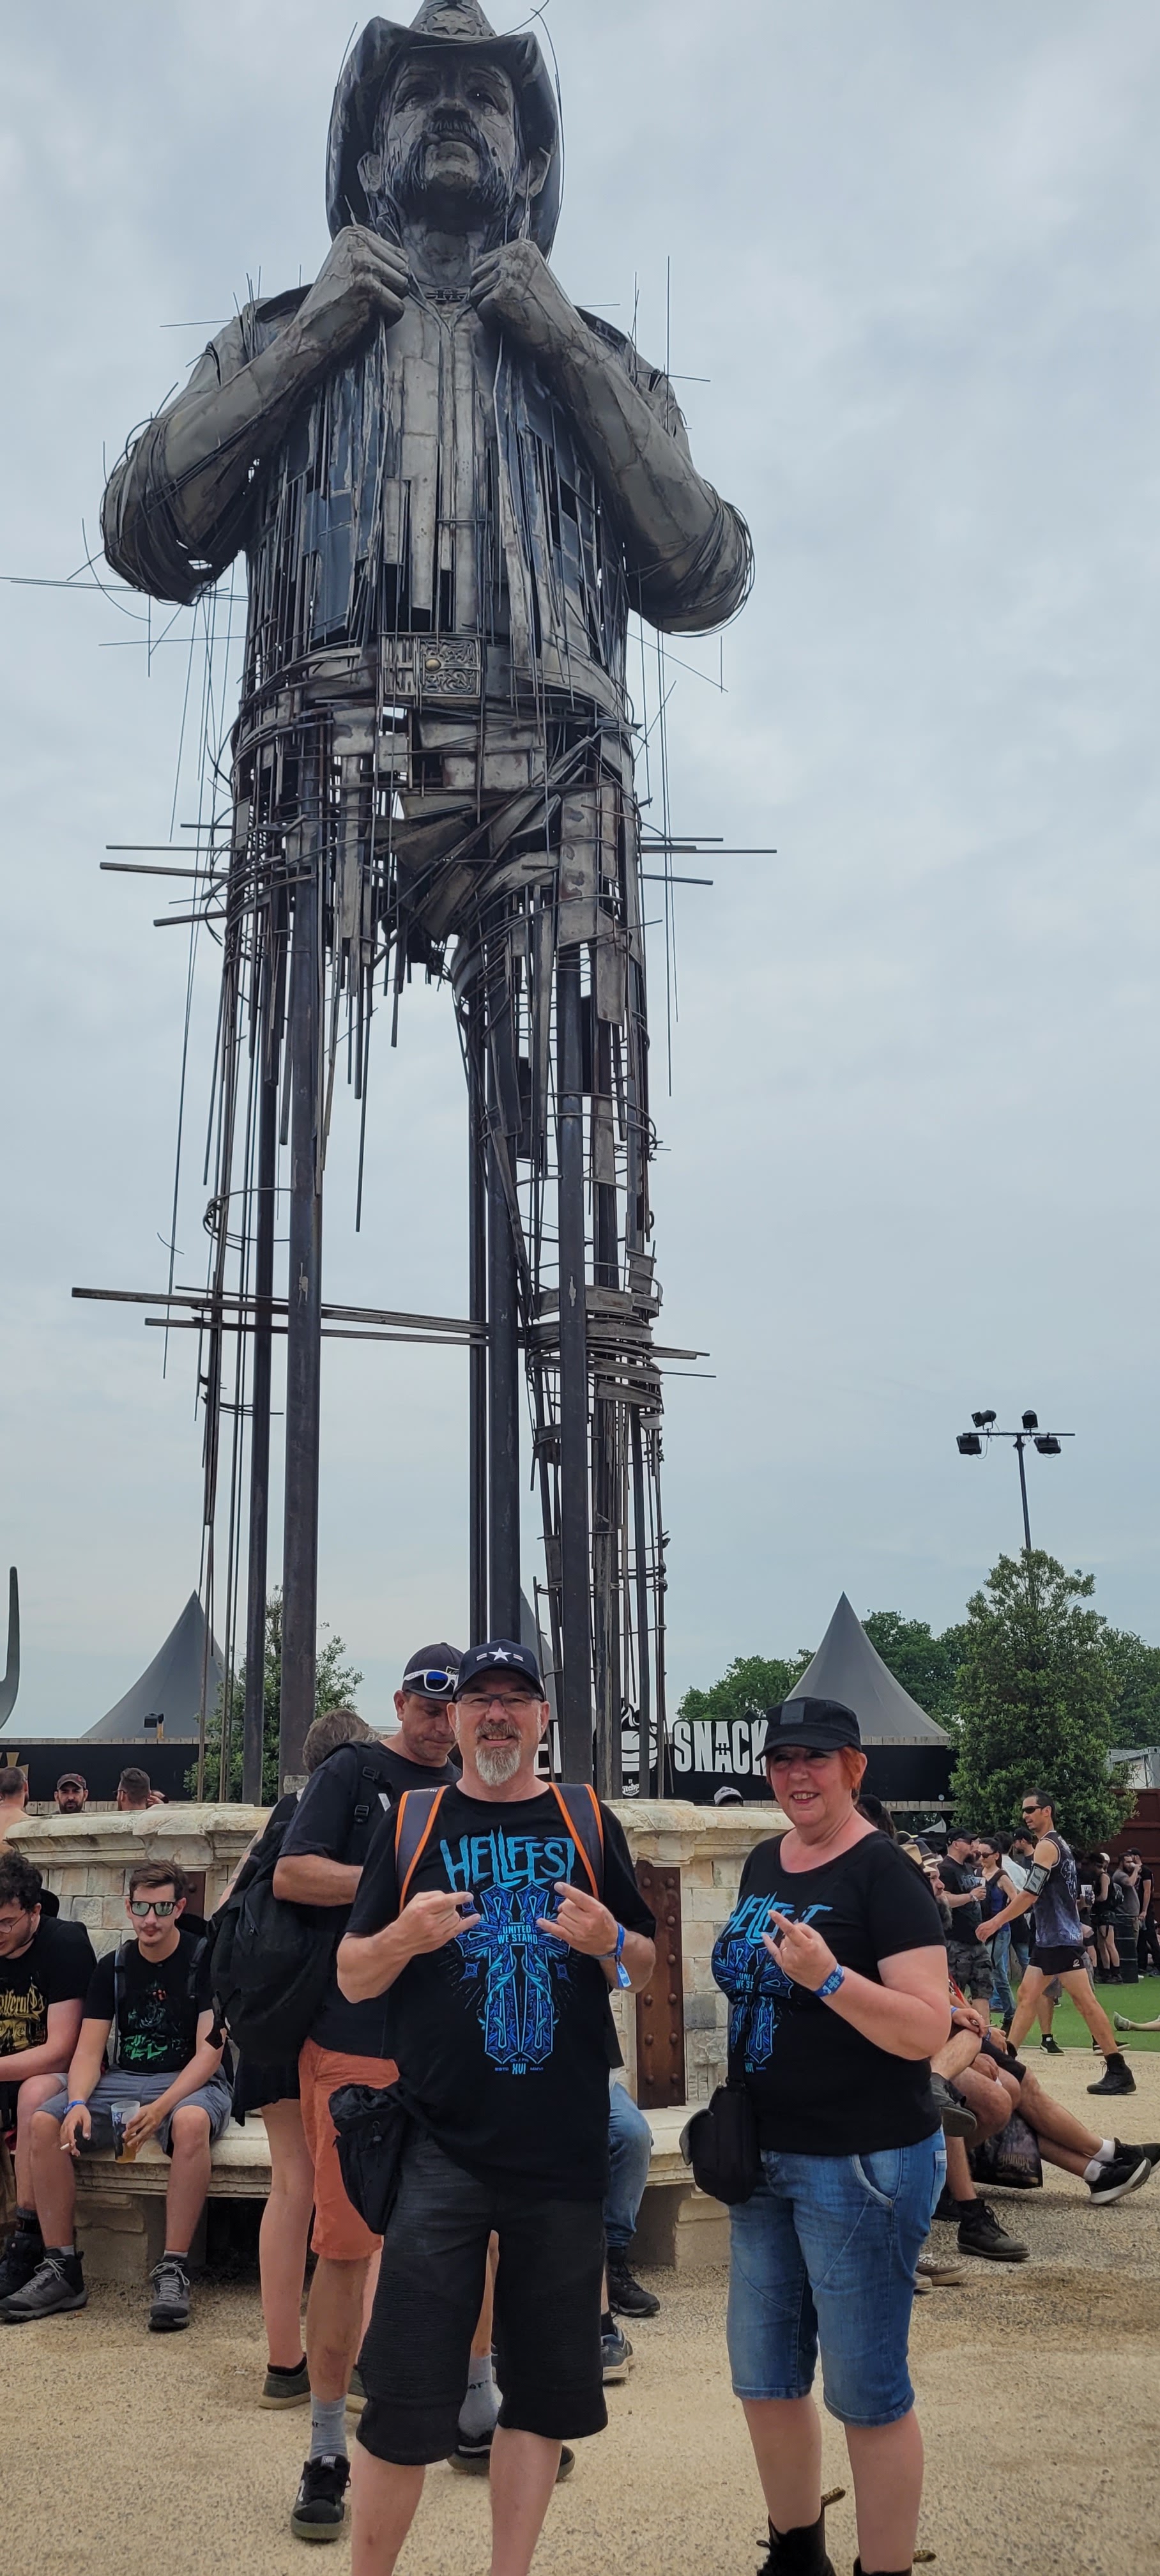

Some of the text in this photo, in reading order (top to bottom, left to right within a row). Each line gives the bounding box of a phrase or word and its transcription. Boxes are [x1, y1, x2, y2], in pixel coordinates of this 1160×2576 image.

[674, 1719, 769, 1777] SNACK
[439, 1825, 576, 1892] HELLFEST
[502, 1924, 531, 1935] UNITED
[497, 1933, 538, 1945] WE STAND
[512, 2063, 526, 2074] XVI
